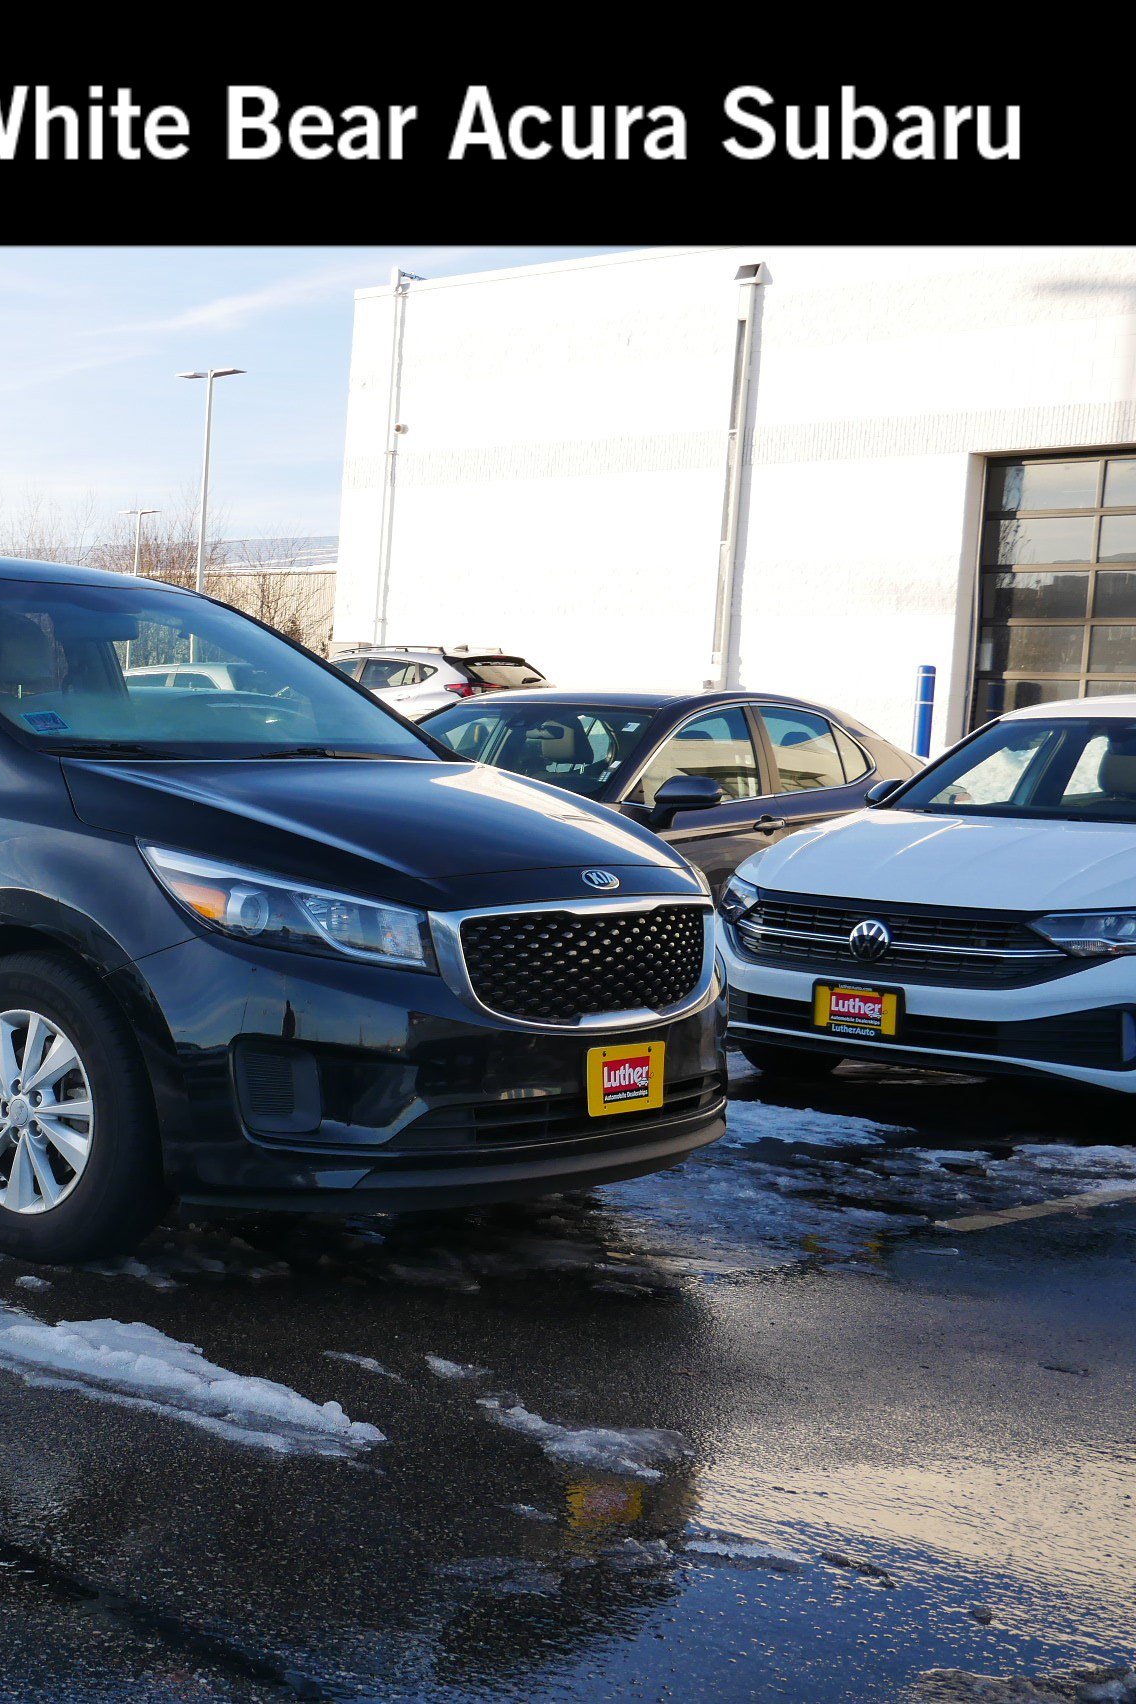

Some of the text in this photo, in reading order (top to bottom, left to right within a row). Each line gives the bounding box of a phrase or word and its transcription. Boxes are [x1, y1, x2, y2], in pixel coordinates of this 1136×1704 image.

[586, 871, 617, 885] KIA
[831, 996, 881, 1014] Luther
[831, 1023, 875, 1036] LutherAuto
[604, 1063, 648, 1088] Luther
